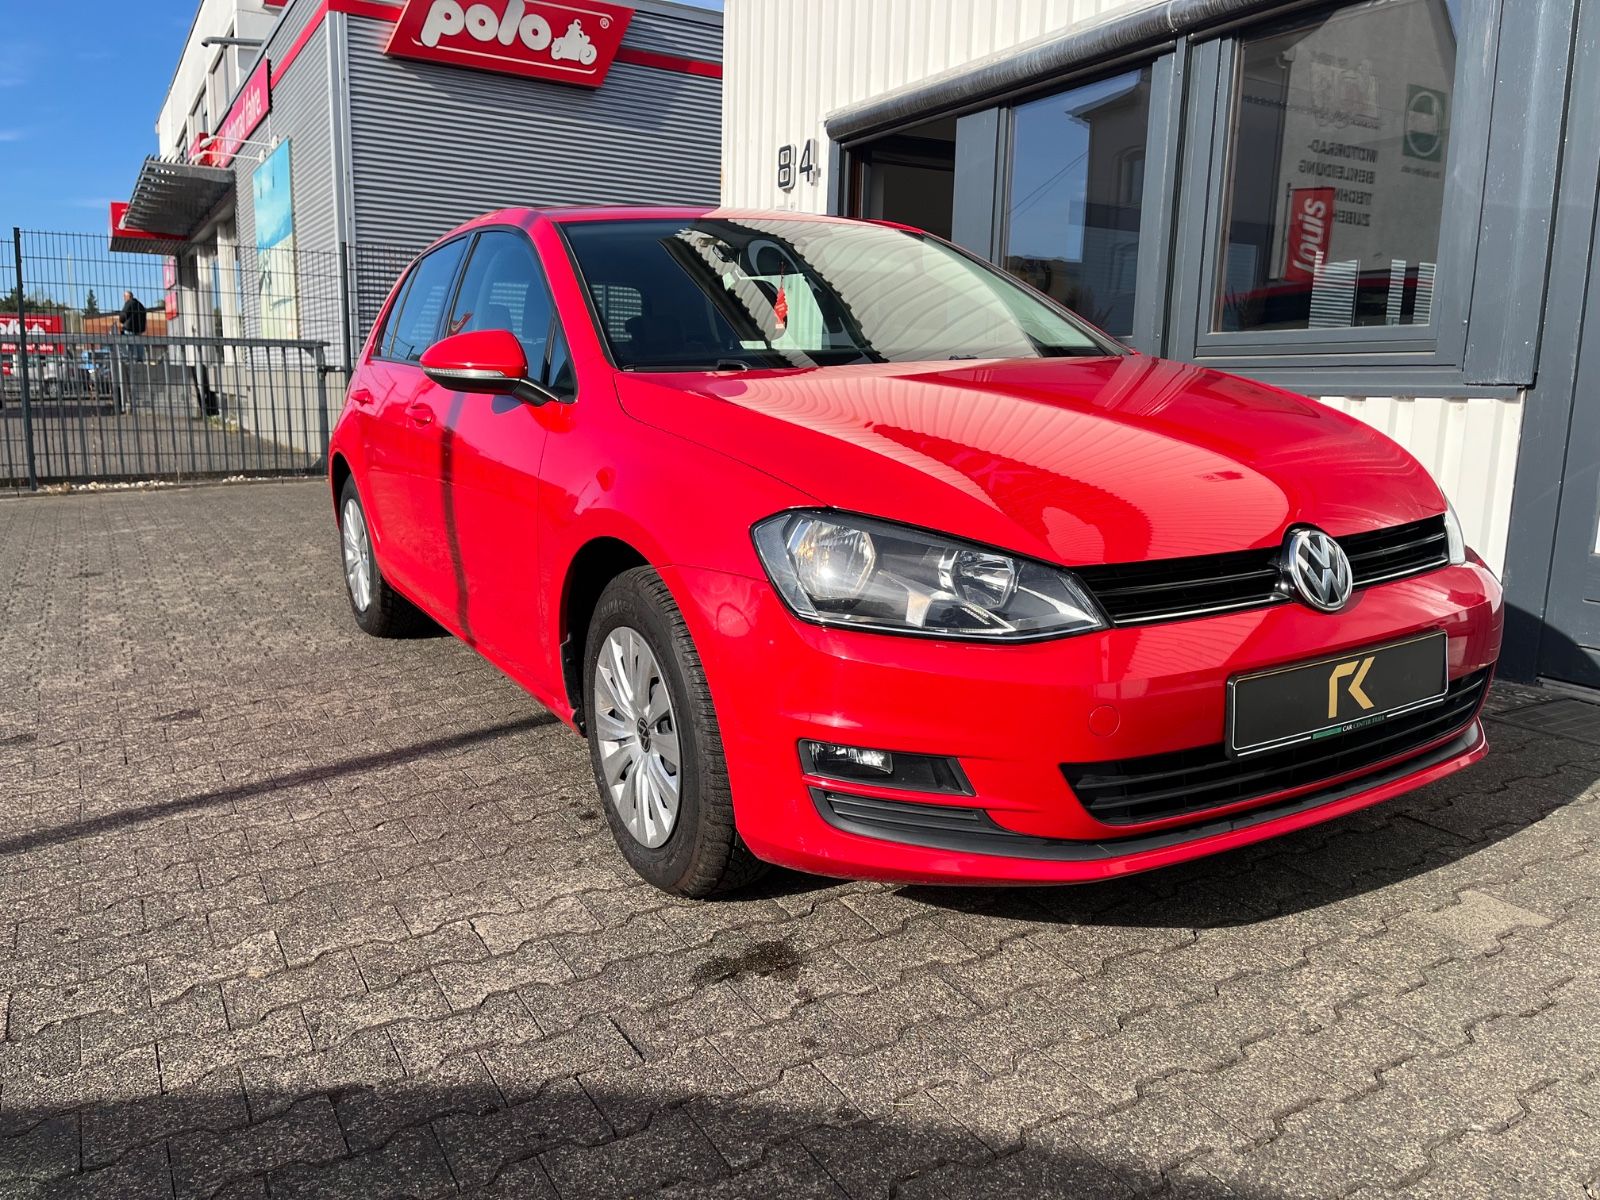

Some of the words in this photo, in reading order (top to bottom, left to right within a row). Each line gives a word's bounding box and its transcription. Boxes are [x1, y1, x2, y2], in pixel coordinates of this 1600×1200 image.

[421, 0, 552, 51] polo
[777, 138, 816, 190] 84
[1342, 724, 1353, 732] CAR
